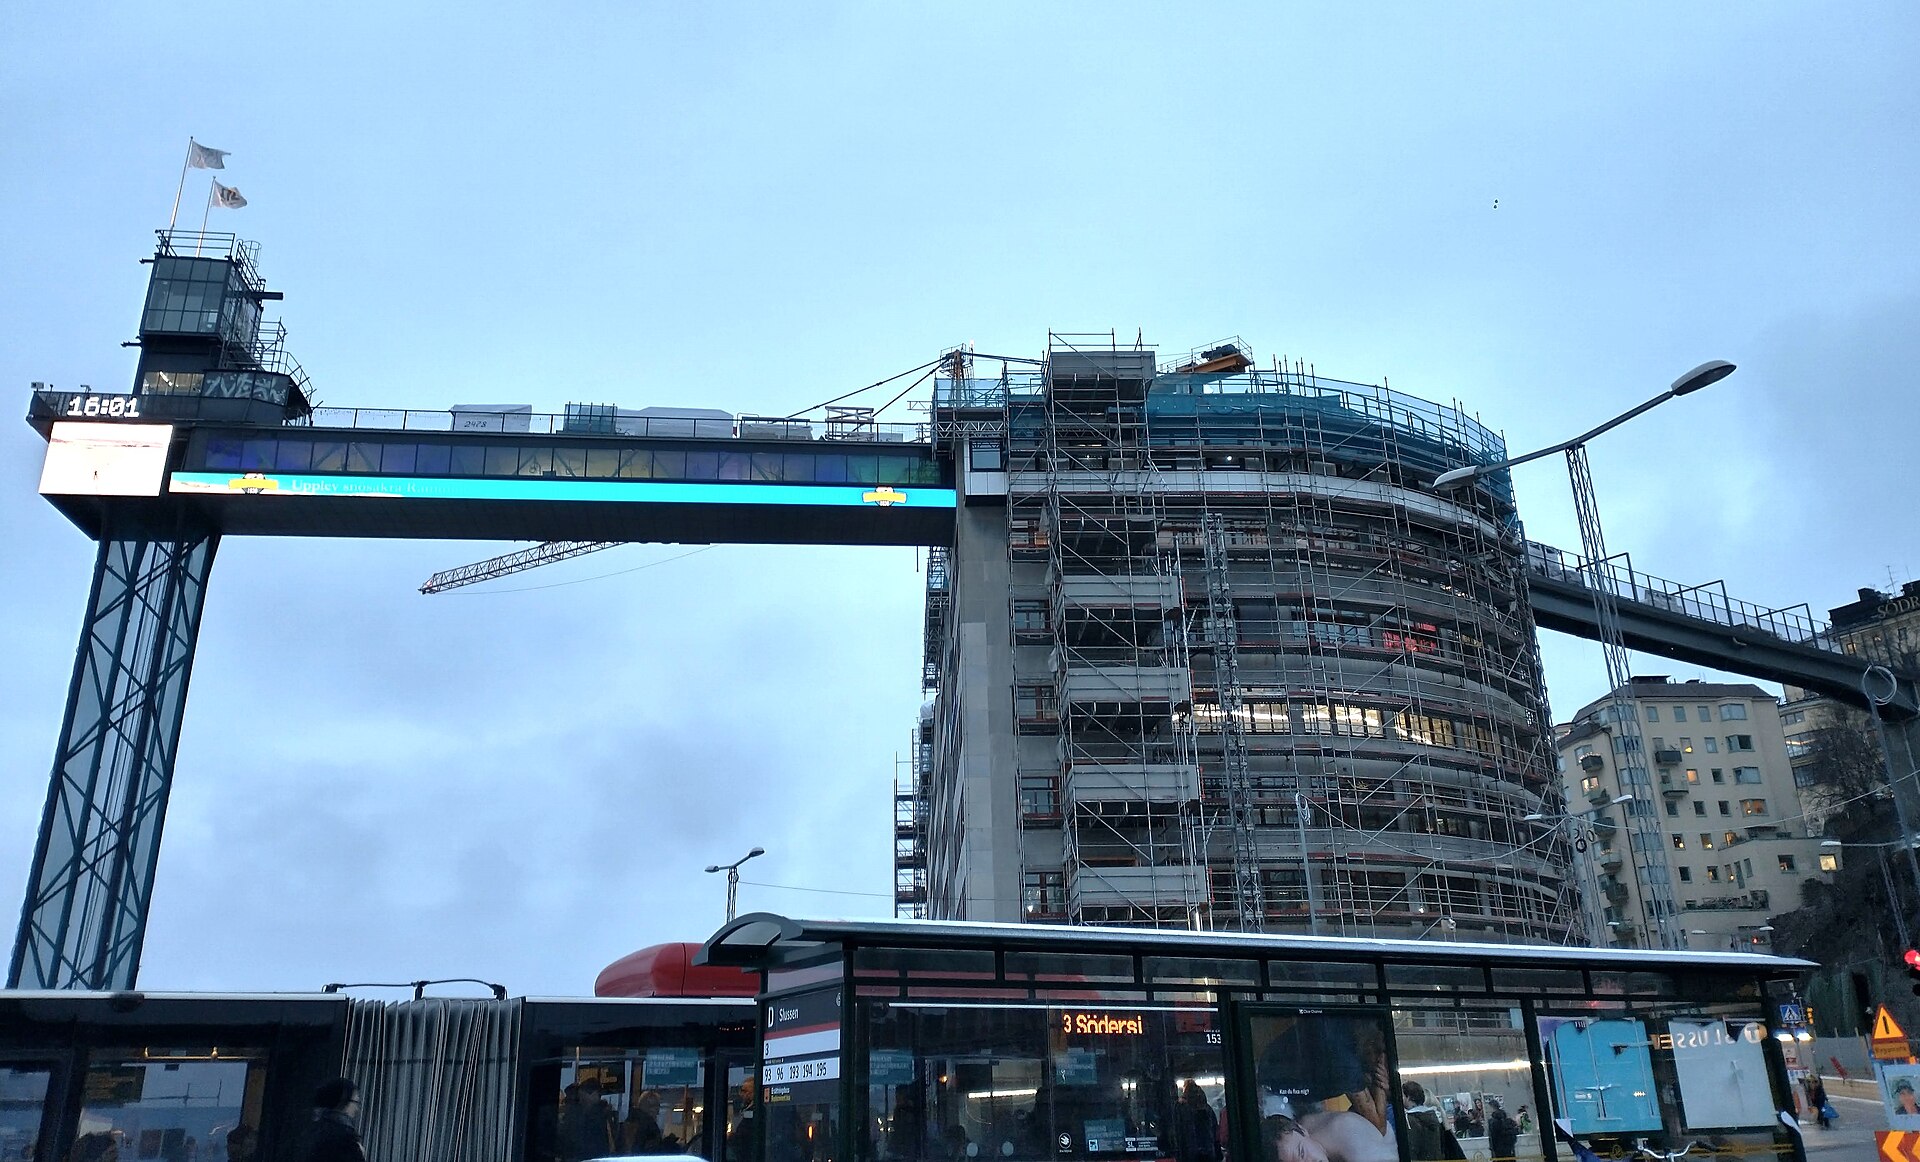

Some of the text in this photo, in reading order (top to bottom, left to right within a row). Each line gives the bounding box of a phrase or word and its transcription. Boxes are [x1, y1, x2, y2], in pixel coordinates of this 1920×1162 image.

[67, 396, 139, 417] 16:01
[291, 479, 338, 493] Upplev
[767, 1006, 799, 1028] D Slussen
[1063, 1014, 1072, 1033] 3
[765, 1043, 770, 1056] 3
[764, 1062, 827, 1081] 93 96 193 194 195
